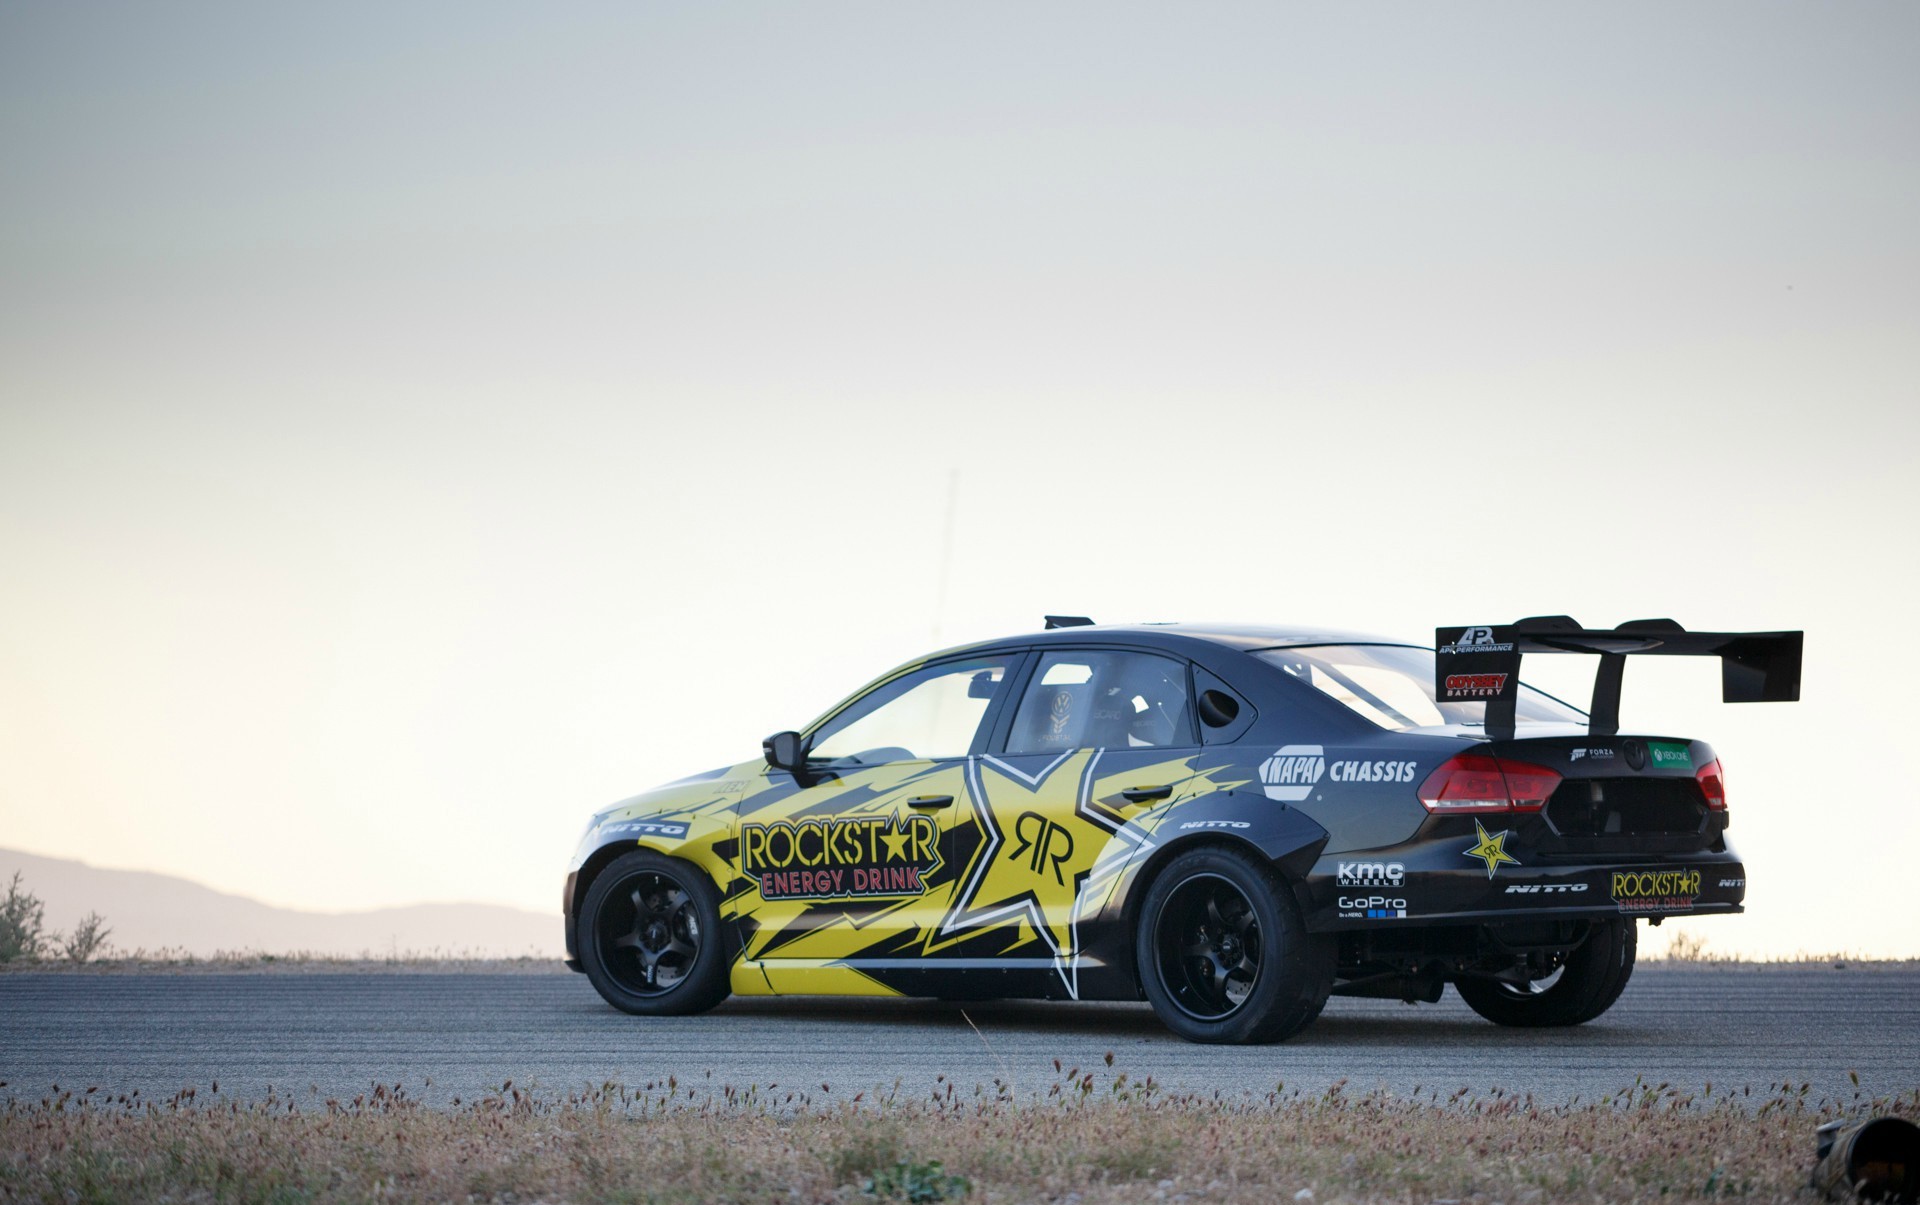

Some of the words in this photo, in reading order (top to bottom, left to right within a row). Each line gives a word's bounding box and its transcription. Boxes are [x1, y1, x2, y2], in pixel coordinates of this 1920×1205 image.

[1456, 645, 1513, 653] PERFORMANCE
[1446, 674, 1508, 689] ODYSSEY
[1589, 748, 1614, 756] FORZA
[1268, 757, 1316, 783] NAPA
[1329, 761, 1417, 782] CHASSIS
[600, 822, 685, 835] NITTO
[1180, 820, 1251, 830] NITTO
[762, 872, 844, 895] ENERGY
[854, 867, 921, 891] DRINK
[1505, 883, 1589, 894] NITTO
[1338, 896, 1407, 909] GoPro
[1619, 898, 1660, 911] ENERGY
[1663, 896, 1694, 909] DRINK
